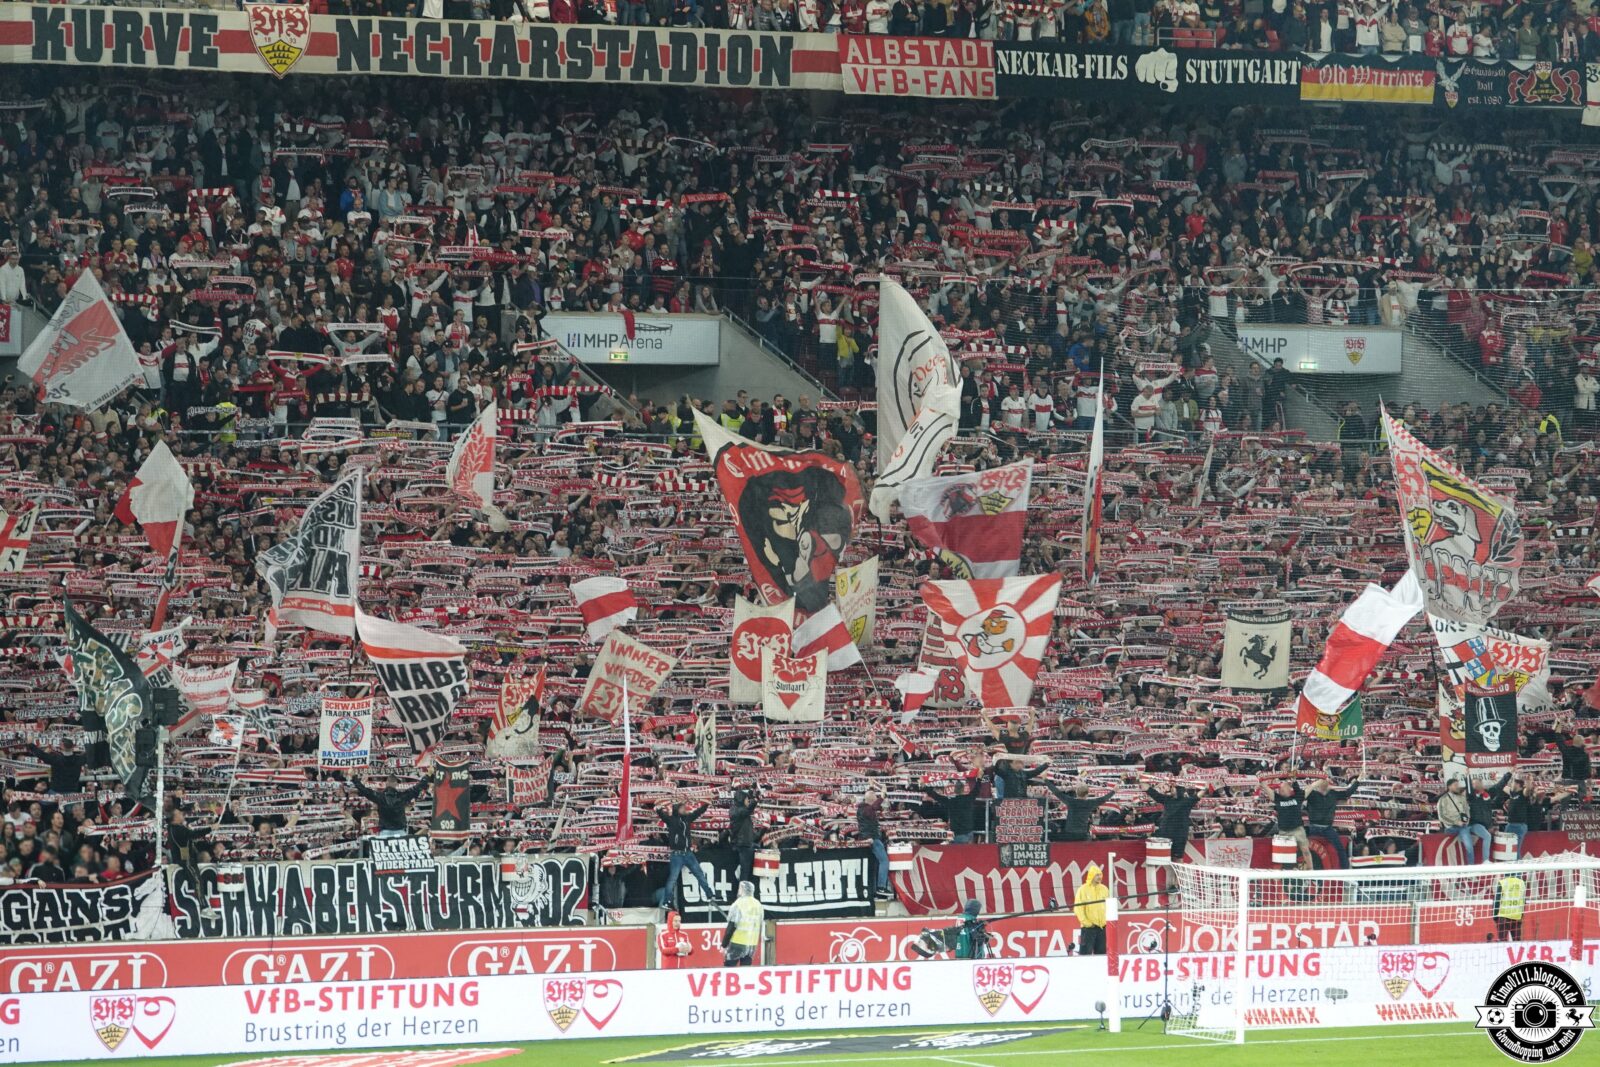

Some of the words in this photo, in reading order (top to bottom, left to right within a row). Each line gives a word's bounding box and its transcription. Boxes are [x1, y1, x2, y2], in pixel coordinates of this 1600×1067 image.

[32, 6, 219, 68] KURVE
[336, 18, 794, 87] NECKARSTADION
[846, 39, 994, 67] ALBSTADT
[997, 50, 1129, 81] NECKAR-FILS
[1185, 57, 1301, 86] STUTTGART
[1319, 66, 1347, 86] Old
[853, 66, 994, 97] VFB-FANS
[584, 333, 619, 349] MHP
[619, 333, 663, 350] Arena
[1252, 337, 1288, 353] MHP
[610, 639, 670, 676] IMMER
[377, 660, 467, 691] WABE
[776, 681, 806, 692] Stuttgart
[324, 700, 371, 711] SCHWABEN
[321, 757, 367, 767] TRACHTEN
[1001, 799, 1038, 807] JEDER
[371, 836, 430, 853] ULTRAS
[895, 831, 948, 839] COMMANDO
[373, 849, 432, 862] BEDEUTET
[375, 859, 435, 870] WIDERSTAND
[1013, 851, 1047, 859] IMMER
[759, 858, 869, 904] BLEIBT!
[1455, 907, 1475, 927] 35
[701, 929, 723, 951] 34
[1380, 950, 1416, 974] VfB
[687, 966, 912, 998] VfB-STIFTUNG
[974, 965, 1014, 989] VfB
[244, 981, 479, 1014] VfB-STIFTUNG
[546, 980, 585, 1002] VfB
[1252, 985, 1320, 1004] Herzen
[92, 997, 135, 1021] VfB
[688, 1005, 785, 1027] Brustring
[795, 1000, 828, 1020] der
[838, 1000, 911, 1018] Herzen
[1376, 1001, 1459, 1022] WINAMAX
[245, 1020, 347, 1045] Brustring
[357, 1017, 392, 1038] der
[402, 1016, 479, 1036] Herzen
